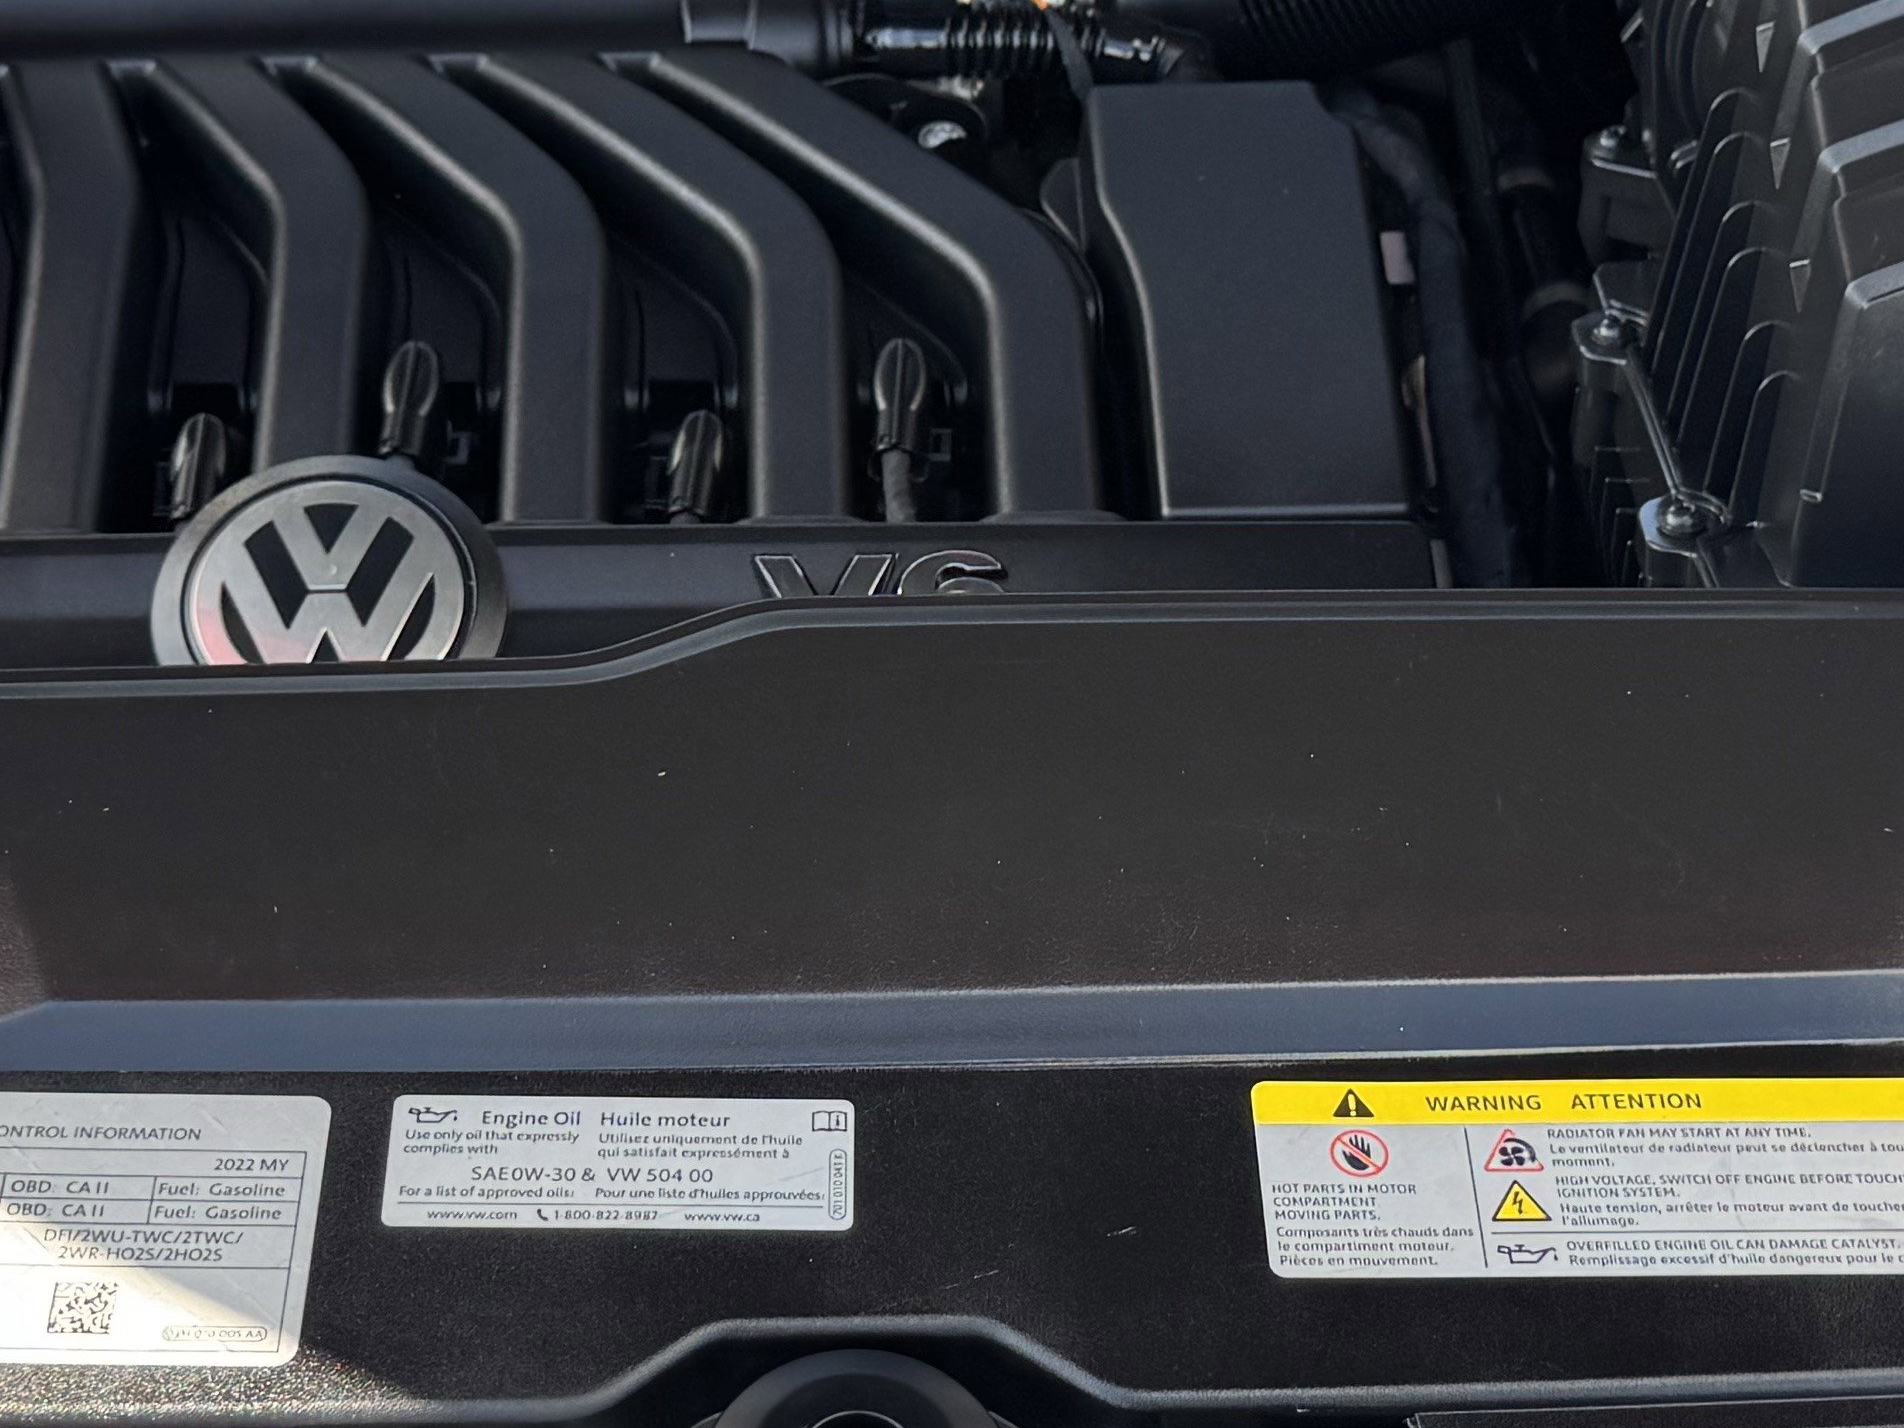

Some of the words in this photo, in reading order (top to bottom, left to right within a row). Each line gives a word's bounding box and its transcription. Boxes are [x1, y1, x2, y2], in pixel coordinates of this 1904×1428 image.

[1426, 1095, 1541, 1111] WARNING
[1571, 1094, 1702, 1109] ATTENTION
[483, 1111, 548, 1129] Engine
[554, 1111, 581, 1126] Oil
[601, 1112, 652, 1127] Huile
[658, 1112, 730, 1127] moteur
[74, 1126, 202, 1140] INFORMATION
[406, 1130, 429, 1140] Use
[434, 1131, 462, 1143] only
[466, 1130, 482, 1140] oil
[486, 1131, 513, 1140] that
[517, 1132, 579, 1144] expressly
[1548, 1128, 1614, 1138] RADIATOR
[1619, 1128, 1644, 1138] FAN
[1649, 1128, 1677, 1138] MAY
[1682, 1128, 1721, 1138] START
[1726, 1128, 1739, 1137] AT
[1745, 1128, 1770, 1137] ANY
[599, 1133, 649, 1144] Utiliser
[653, 1134, 737, 1146] uniquement
[741, 1134, 758, 1145] de
[404, 1144, 463, 1155] complies
[468, 1145, 497, 1154] with
[598, 1148, 619, 1160] qui
[624, 1147, 677, 1157] satisfait
[682, 1148, 777, 1160] expressément
[782, 1147, 790, 1158] à
[1550, 1144, 1565, 1154] Le
[1569, 1144, 1643, 1153] ventilateur
[1649, 1144, 1665, 1153] de
[1670, 1144, 1731, 1152] radiateur
[1737, 1144, 1767, 1154] peut
[1772, 1144, 1786, 1152] se
[1791, 1143, 1864, 1152] déclencher
[214, 1158, 254, 1172] 2022
[260, 1158, 289, 1172] MY
[581, 1167, 595, 1181] &
[607, 1168, 641, 1181] VW
[646, 1168, 682, 1182] 504
[689, 1169, 713, 1182] 00
[1556, 1176, 1588, 1185] HIGH
[1660, 1175, 1711, 1185] SWITCH
[1716, 1174, 1740, 1184] OFF
[1745, 1174, 1796, 1184] ENGINE
[1800, 1174, 1852, 1183] BEFORE
[158, 1183, 199, 1196] Fuel:
[209, 1183, 286, 1196] Gasoline
[400, 1186, 420, 1196] For
[424, 1188, 432, 1196] a
[436, 1186, 455, 1197] list
[461, 1186, 474, 1197] of
[478, 1188, 542, 1200] approved
[596, 1188, 625, 1198] Pour
[631, 1190, 654, 1198] une
[658, 1188, 686, 1198] liste
[1272, 1184, 1298, 1193] HOT
[1304, 1184, 1344, 1193] PARTS
[1349, 1184, 1362, 1193] IN
[1368, 1184, 1416, 1194] MOTOR
[1558, 1188, 1618, 1198] IGNITION
[154, 1205, 196, 1219] Fuel:
[206, 1206, 282, 1220] Gasoline
[1561, 1203, 1601, 1213] Haute
[1717, 1202, 1729, 1212] le
[1734, 1203, 1784, 1212] moteur
[1789, 1203, 1828, 1212] avant
[1832, 1202, 1848, 1212] de
[1853, 1202, 1904, 1211] toucher
[427, 1211, 517, 1220] www.vw.com
[684, 1212, 760, 1221] www.vw.ca
[1275, 1210, 1330, 1220] MOVING
[1277, 1227, 1359, 1239] Composants
[1363, 1226, 1388, 1237] très
[1391, 1227, 1438, 1237] chauds
[1442, 1227, 1474, 1237] dans
[1278, 1241, 1290, 1250] le
[1295, 1241, 1394, 1253] compartiment
[1567, 1241, 1650, 1251] OVERFILLED
[1655, 1240, 1706, 1250] ENGINE
[1710, 1240, 1733, 1250] OIL
[1737, 1240, 1764, 1250] CAN
[1770, 1239, 1827, 1249] DAMAGE
[1280, 1254, 1323, 1265] Pièces
[1328, 1257, 1344, 1265] en
[1569, 1254, 1656, 1267] Remplissage
[1661, 1254, 1714, 1264] excessif
[1770, 1254, 1842, 1266] dangereux
[1847, 1254, 1877, 1265] pour
[1881, 1253, 1894, 1263] le
